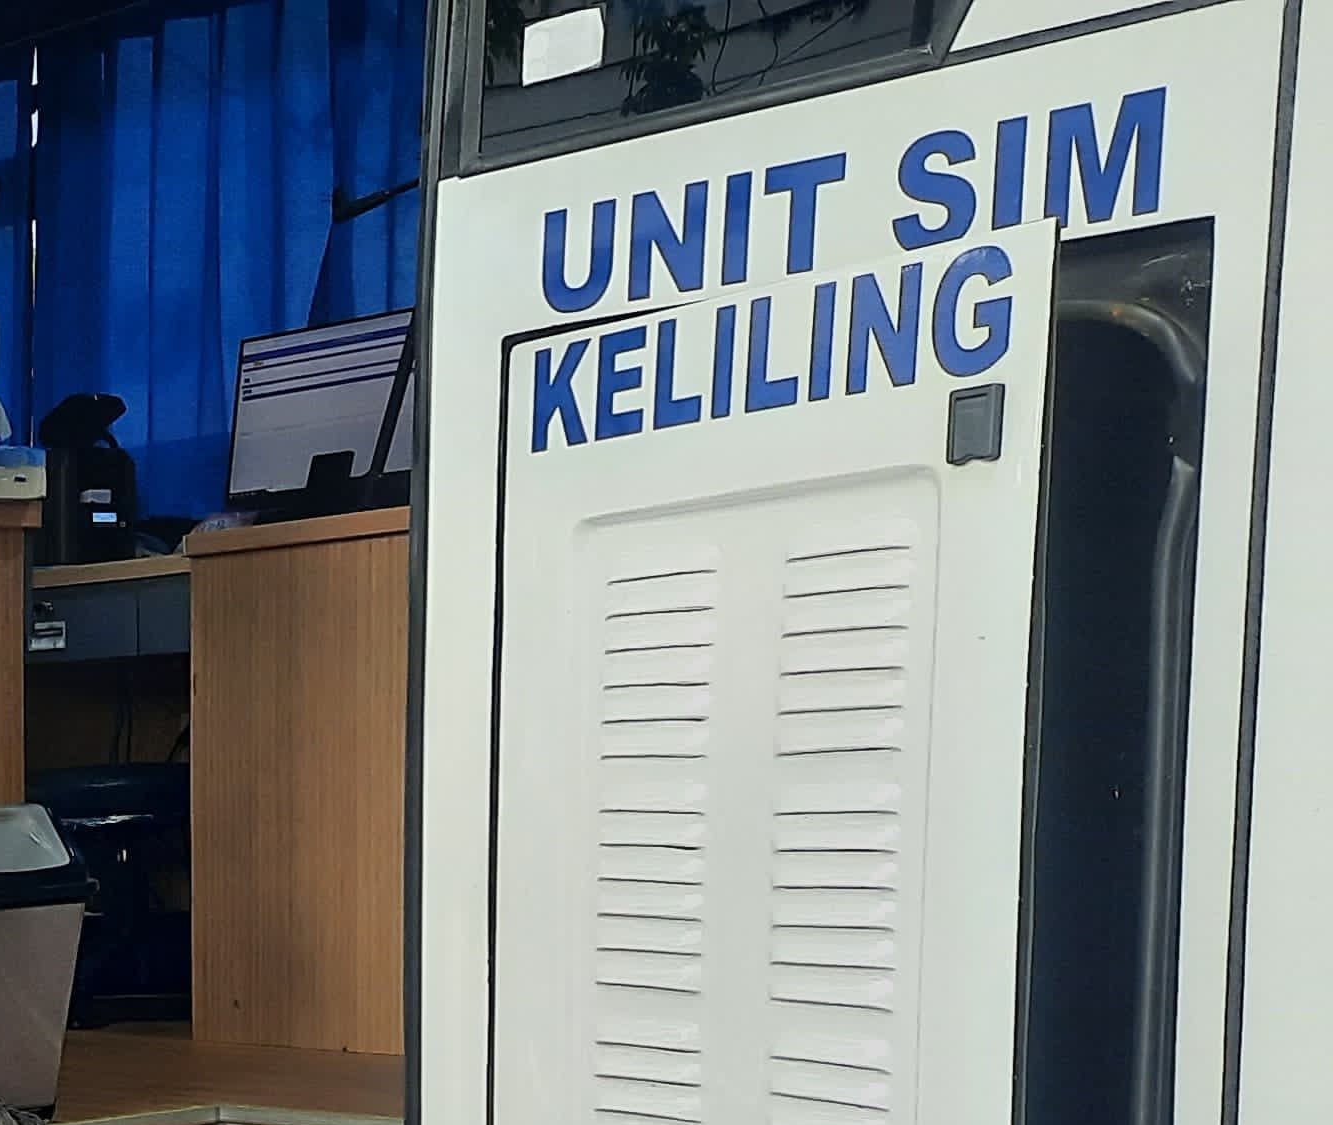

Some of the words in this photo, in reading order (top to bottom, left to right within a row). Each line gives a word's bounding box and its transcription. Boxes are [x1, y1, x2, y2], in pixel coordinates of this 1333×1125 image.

[540, 151, 848, 314] UNIT
[891, 85, 1168, 251] SIM
[531, 244, 1014, 454] KELILING
